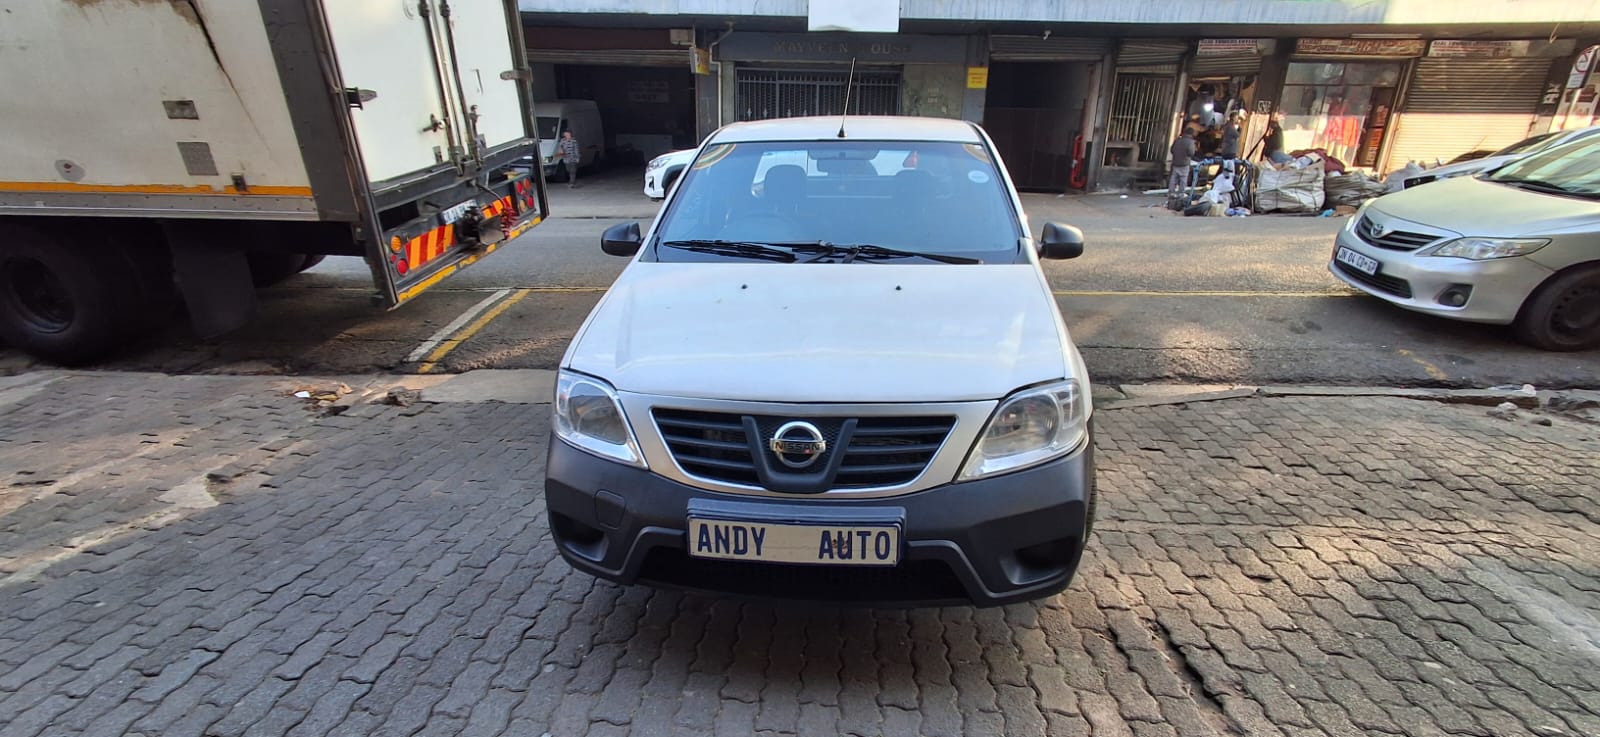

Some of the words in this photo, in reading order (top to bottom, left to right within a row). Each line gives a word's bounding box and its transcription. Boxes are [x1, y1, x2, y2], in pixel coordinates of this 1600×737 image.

[775, 441, 820, 451] NISSAN
[697, 523, 766, 556] ANDY
[818, 530, 890, 560] AUTO
